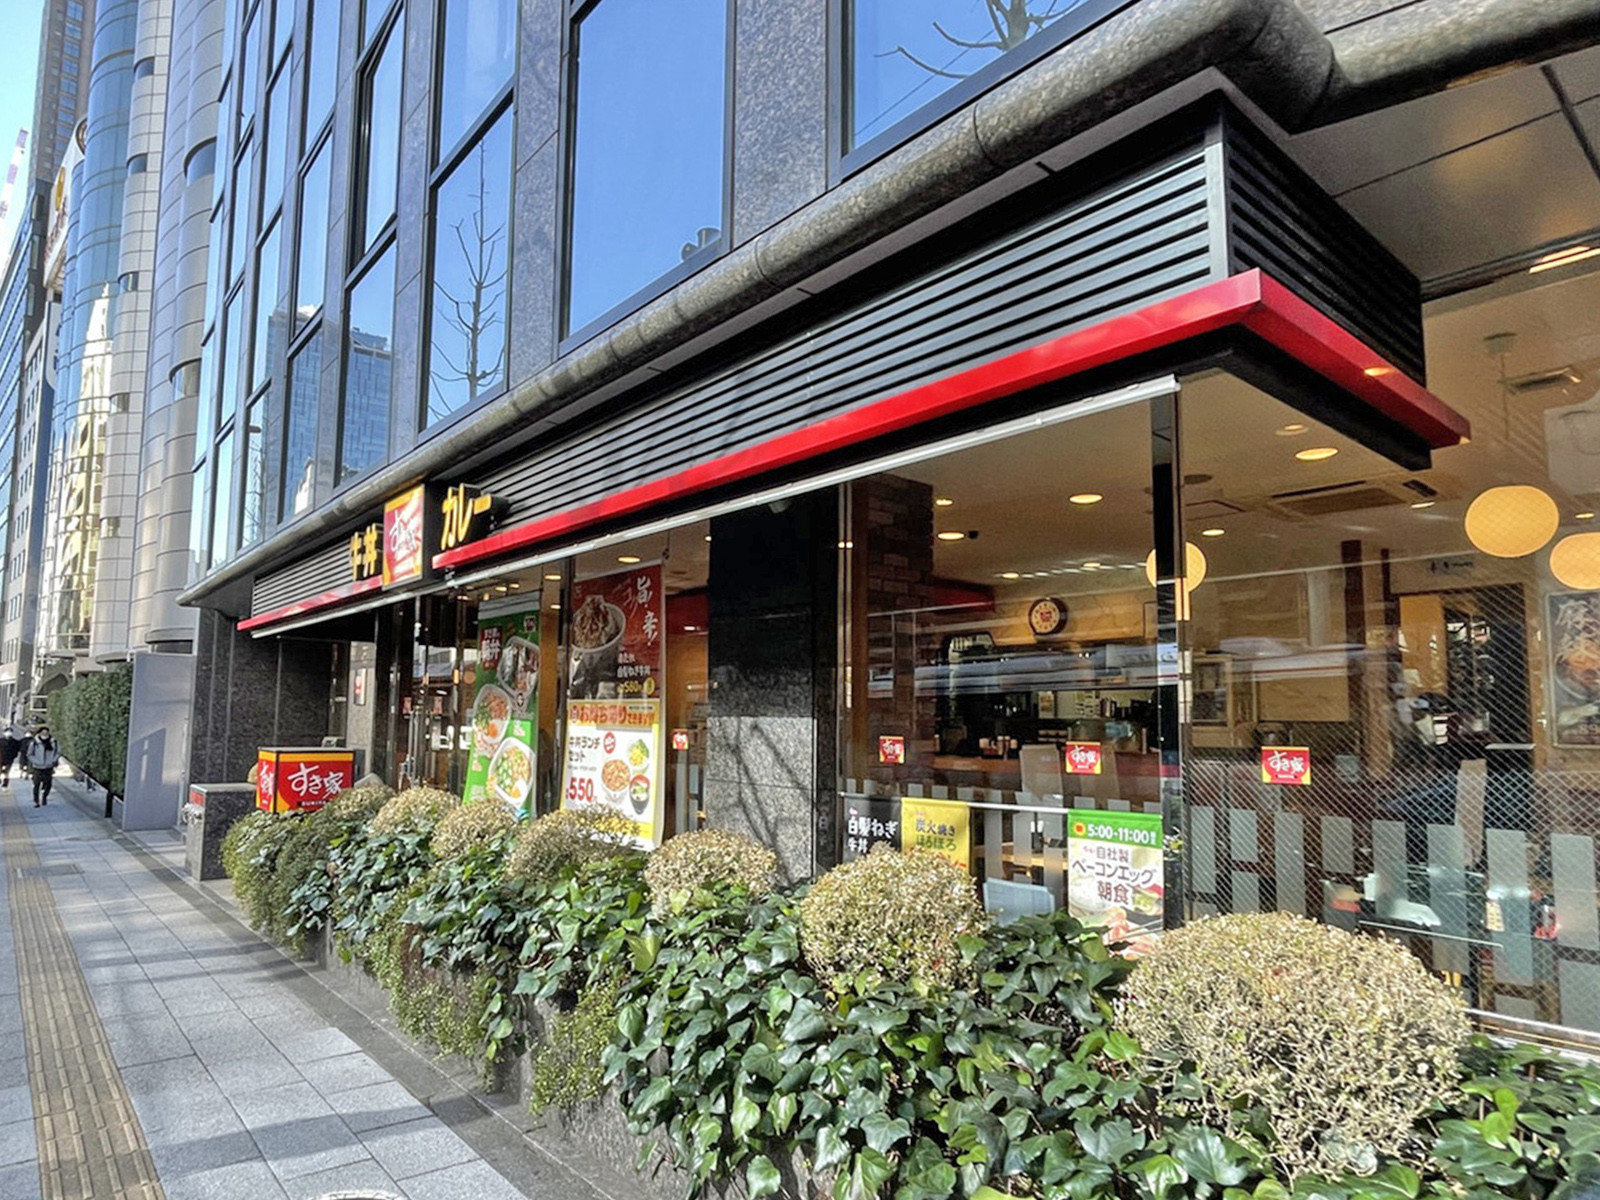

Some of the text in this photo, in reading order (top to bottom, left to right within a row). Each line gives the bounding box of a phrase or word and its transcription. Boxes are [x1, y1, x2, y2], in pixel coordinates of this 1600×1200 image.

[441, 482, 492, 551] カレー
[350, 523, 378, 581] 牛丼
[1267, 750, 1305, 775] すき家
[287, 762, 345, 799] すき家
[569, 776, 594, 802] 550
[848, 816, 899, 838] 白髪ねぎ
[915, 818, 956, 837] 炭火焼き
[848, 837, 869, 854] 牛丼
[1096, 846, 1129, 864] 自社製
[1072, 858, 1157, 885] ベーコンエッグ
[1097, 880, 1129, 905] 朝食
